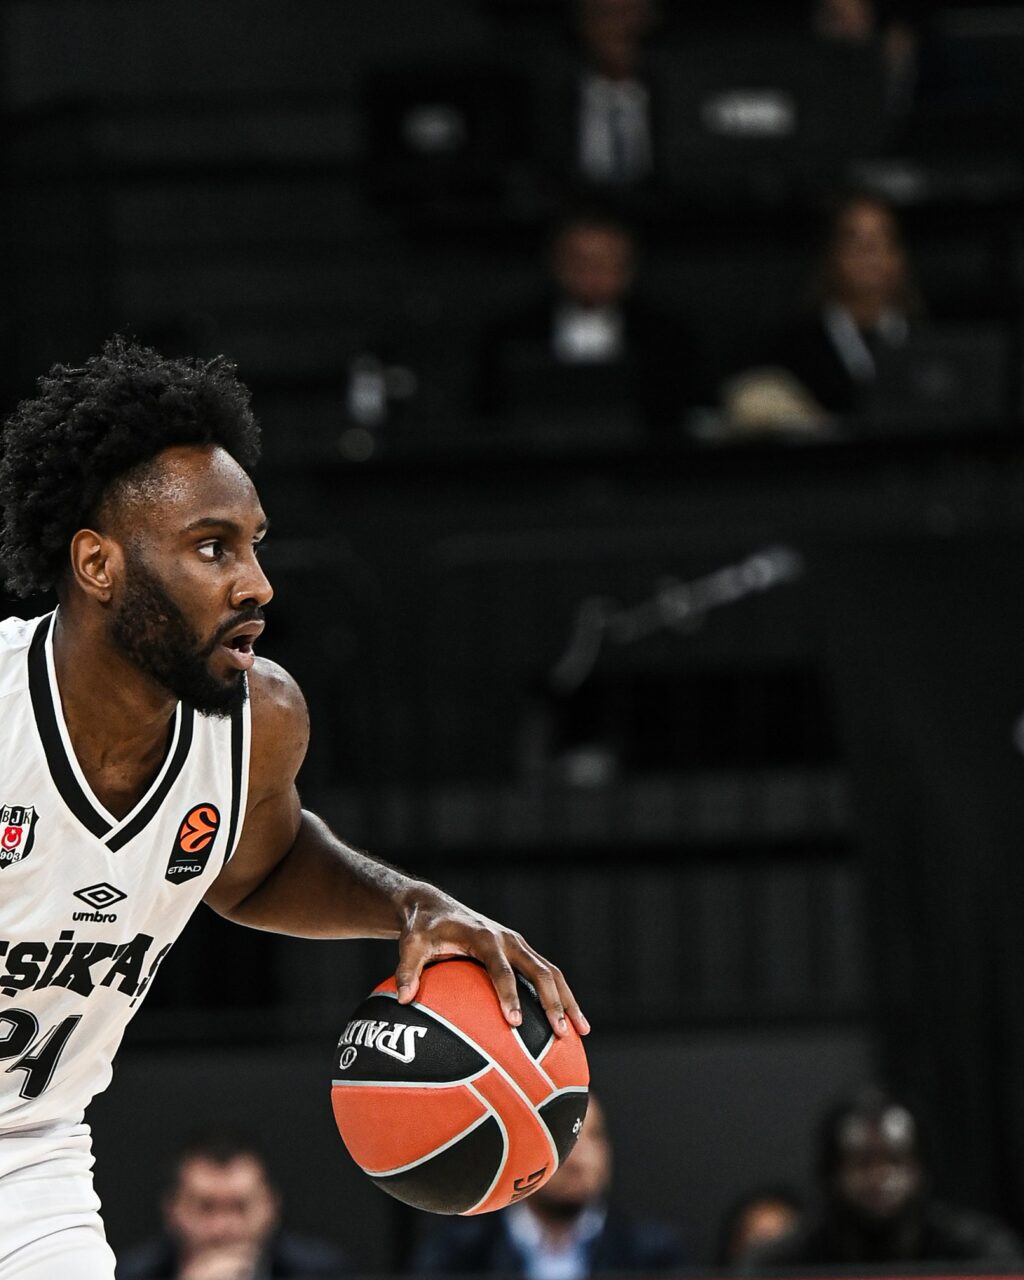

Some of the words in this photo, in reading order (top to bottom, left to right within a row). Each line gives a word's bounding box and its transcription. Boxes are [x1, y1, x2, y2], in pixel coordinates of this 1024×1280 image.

[1, 810, 31, 825] BJK
[167, 865, 202, 875] ETIHAD
[72, 910, 118, 923] umbro
[337, 1019, 429, 1064] SPALD
